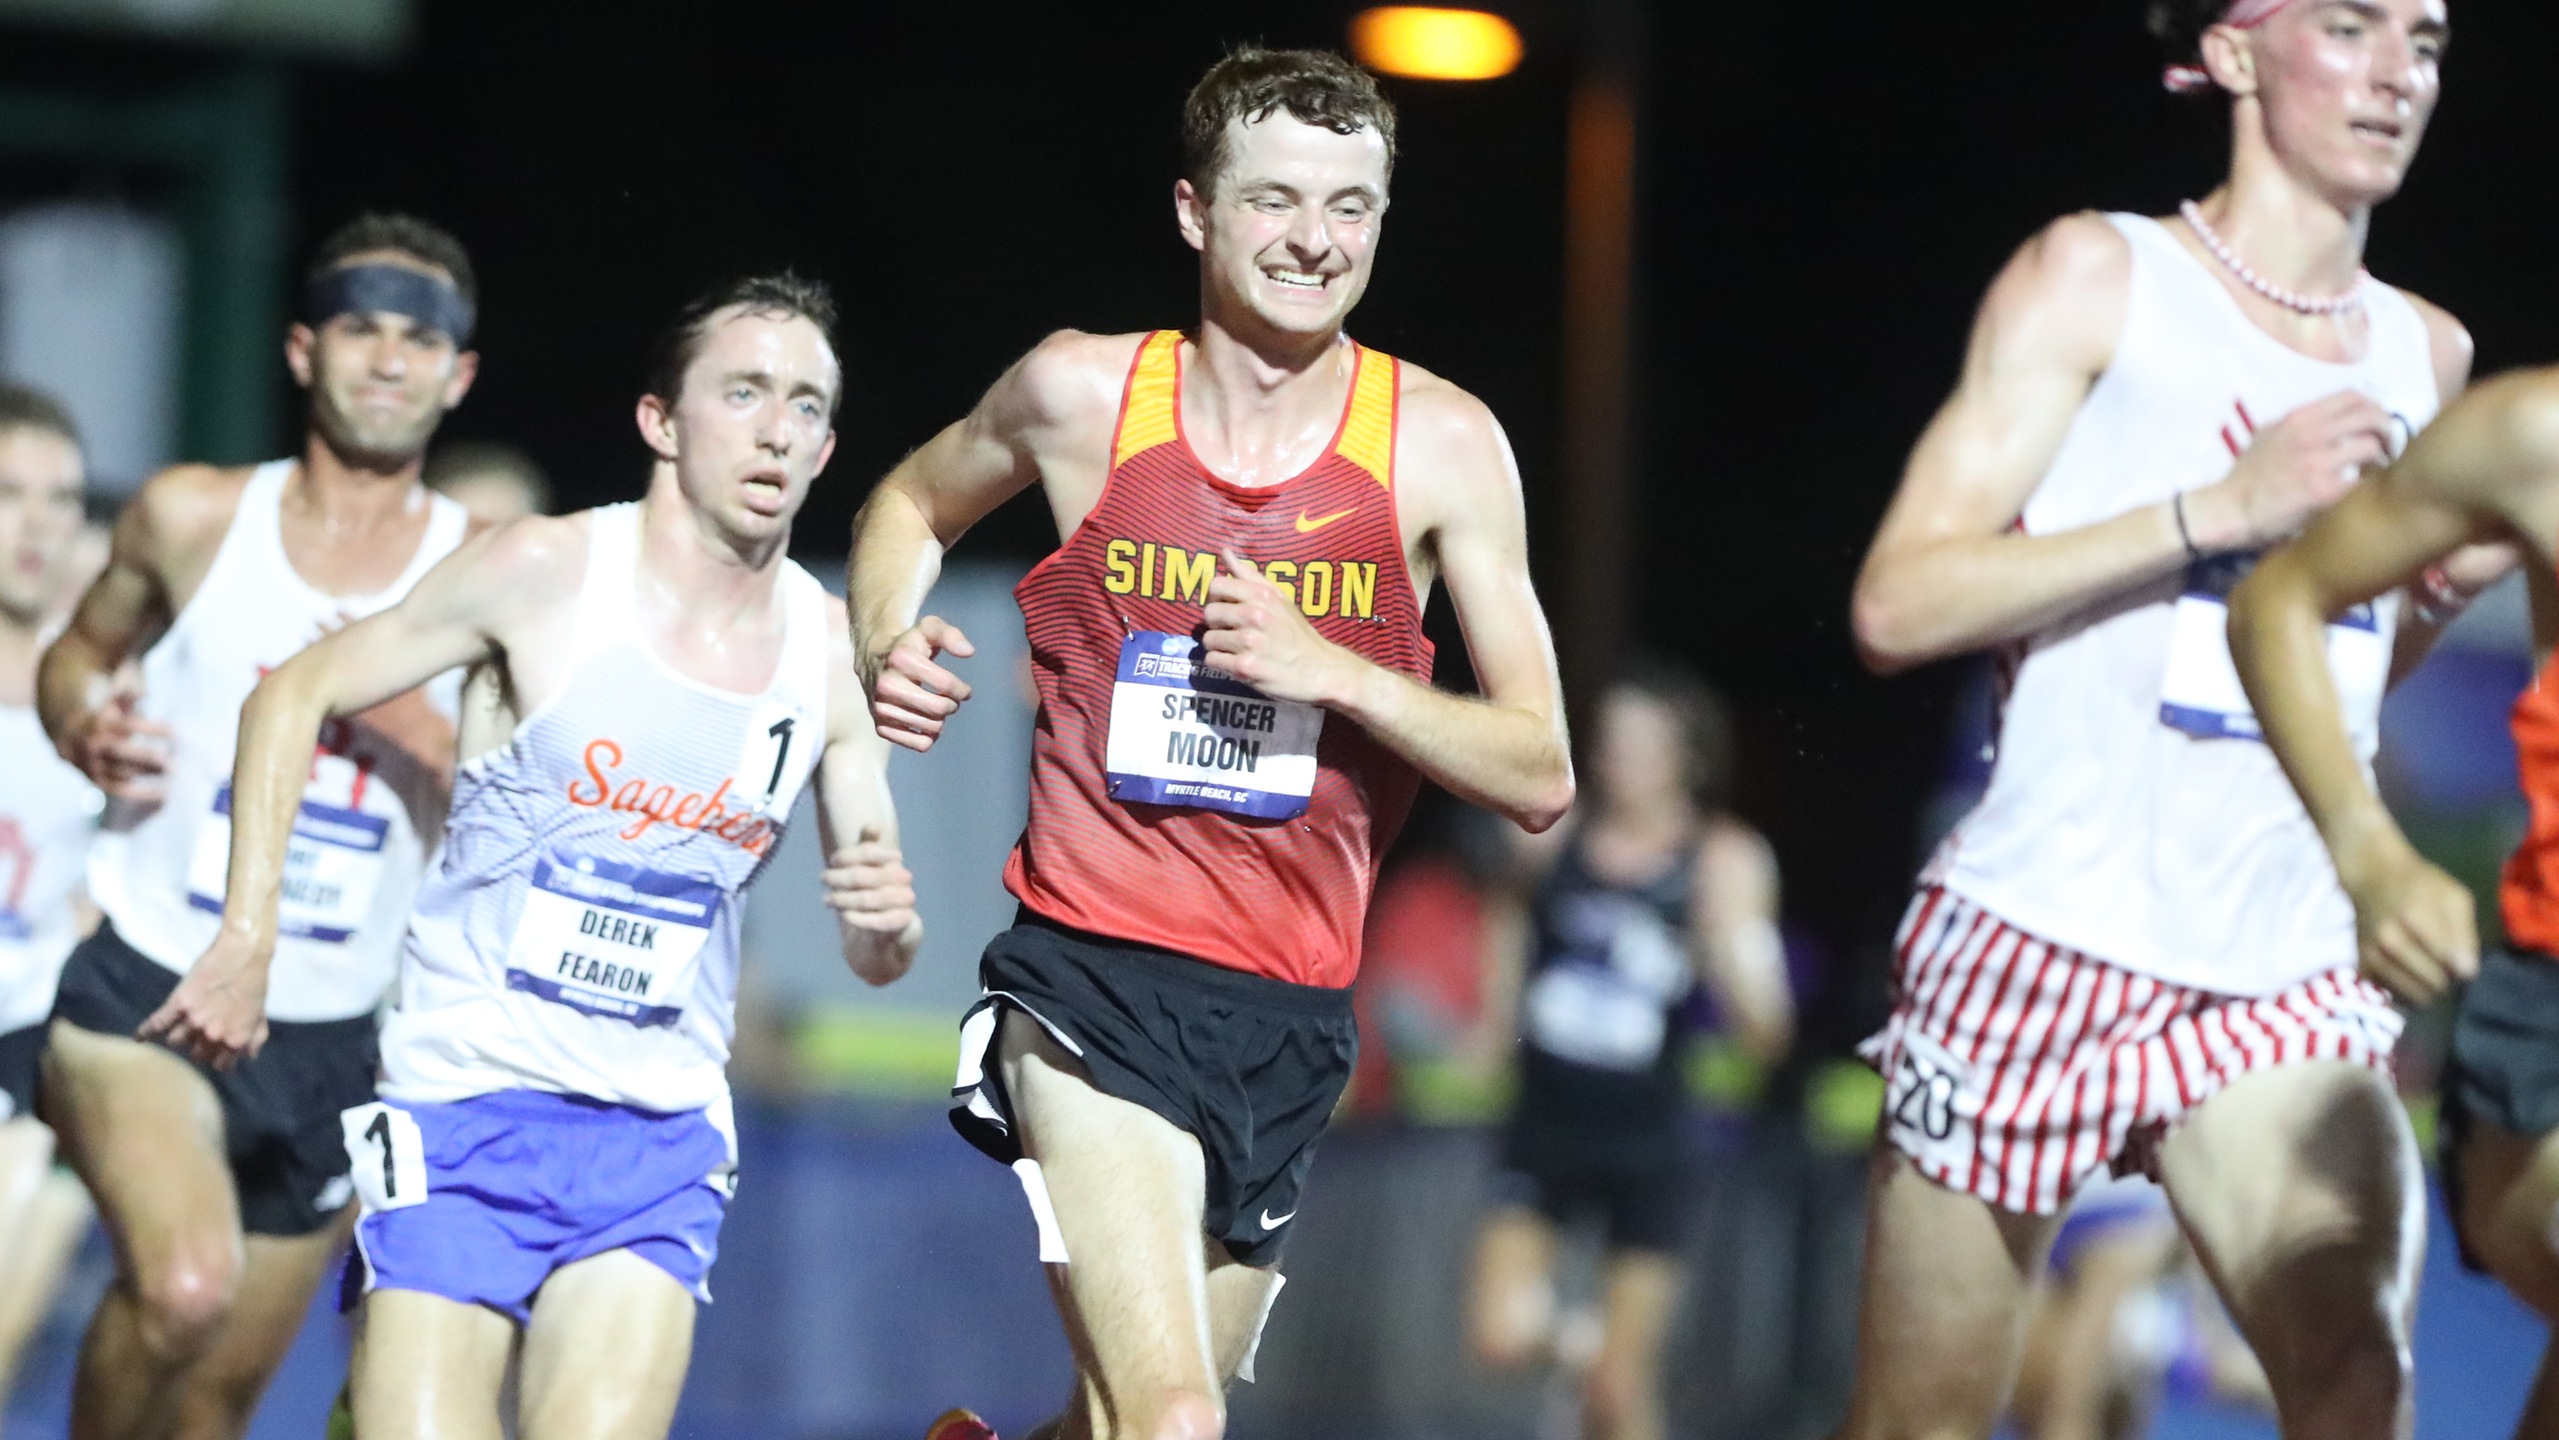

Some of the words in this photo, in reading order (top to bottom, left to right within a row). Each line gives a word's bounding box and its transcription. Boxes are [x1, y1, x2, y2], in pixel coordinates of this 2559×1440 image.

[1104, 538, 1379, 620] SIMSON
[1162, 693, 1278, 734] SPENCER
[768, 716, 796, 804] 1
[1166, 731, 1261, 773] MOON
[1165, 783, 1200, 796] MYRTLE
[1199, 785, 1232, 802] BEACH,
[1233, 790, 1249, 803] SC
[580, 909, 658, 950] DEREK
[558, 951, 652, 996] FEARON
[365, 1111, 396, 1199] 1
